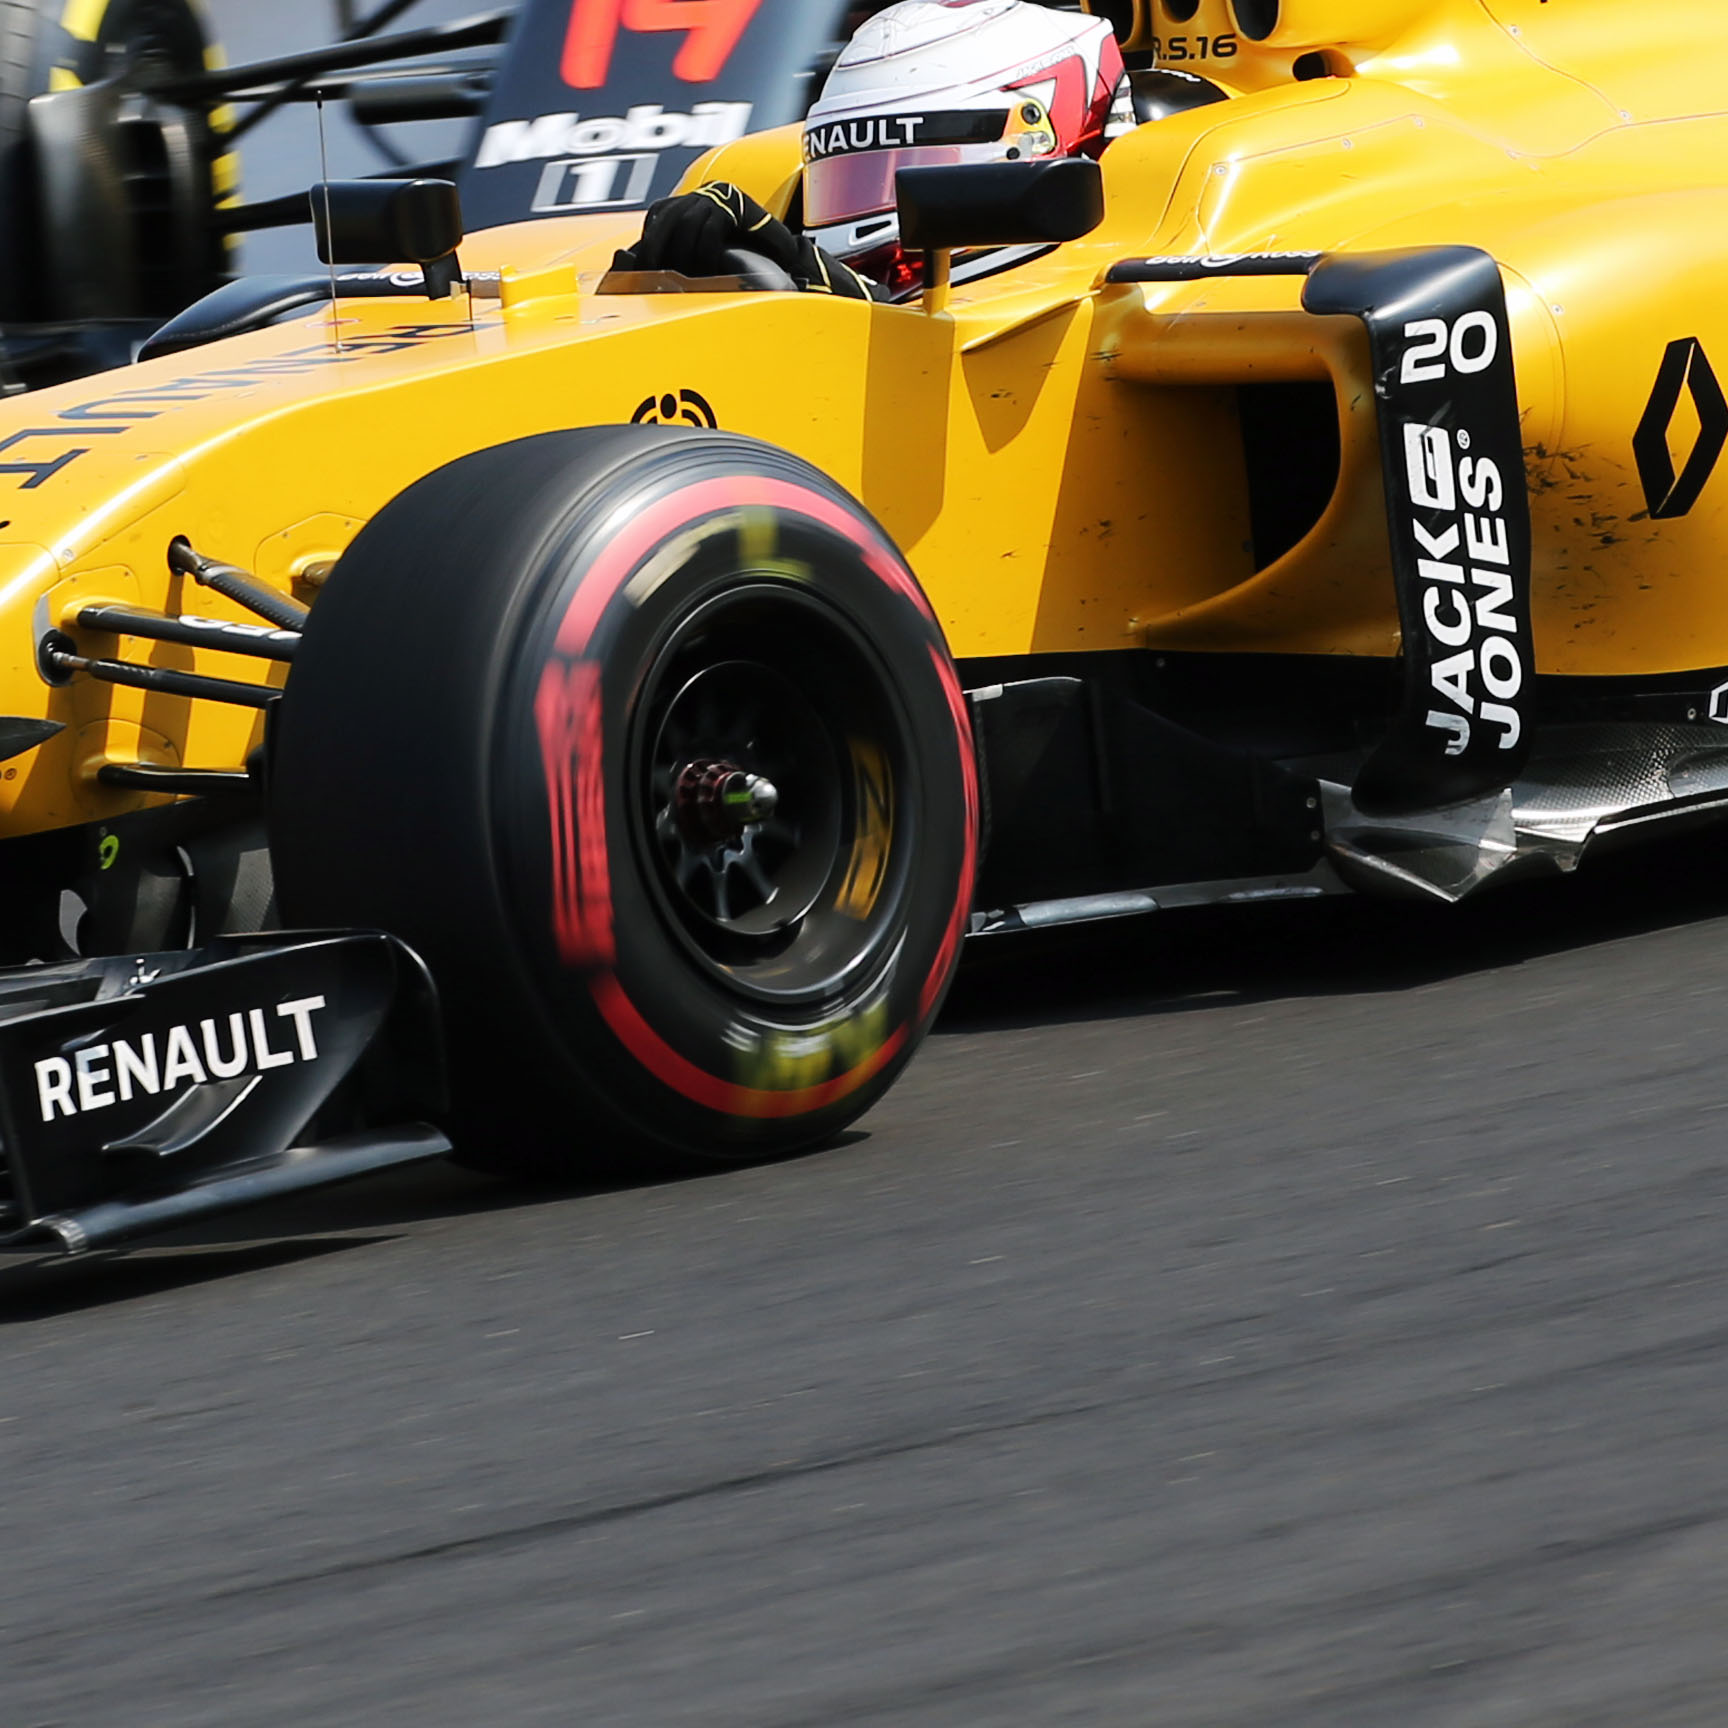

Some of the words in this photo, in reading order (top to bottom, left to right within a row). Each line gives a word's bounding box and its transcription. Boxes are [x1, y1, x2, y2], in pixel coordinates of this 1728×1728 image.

[475, 102, 754, 168] Mobil
[1400, 310, 1498, 384] 20
[1413, 517, 1476, 756] JACK
[34, 994, 326, 1122] RENAULT
